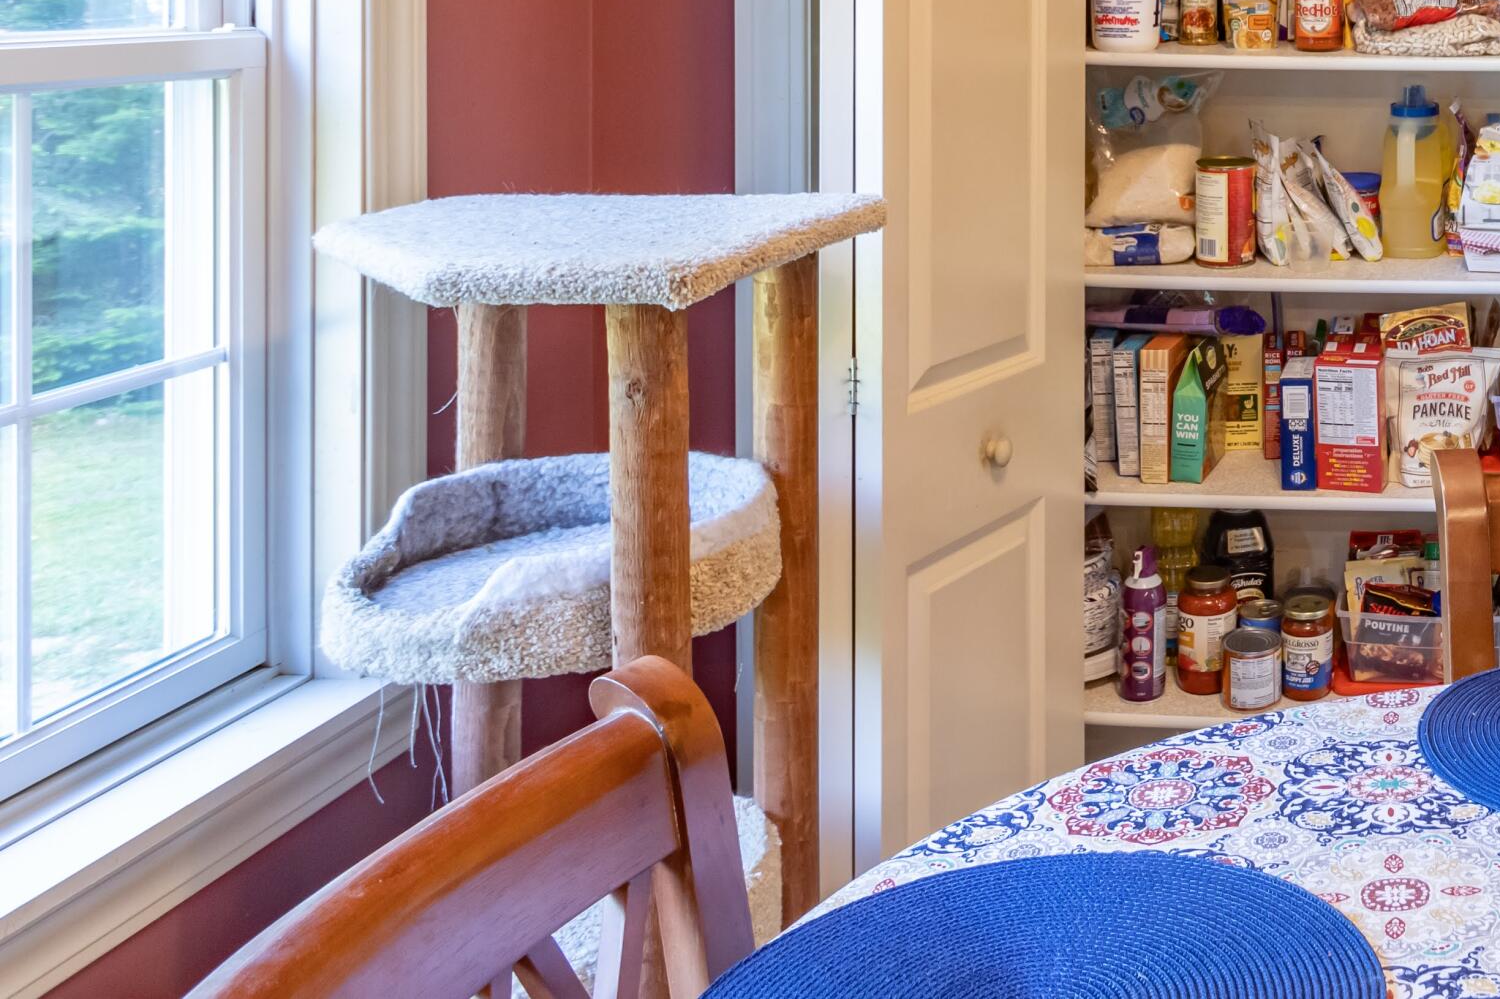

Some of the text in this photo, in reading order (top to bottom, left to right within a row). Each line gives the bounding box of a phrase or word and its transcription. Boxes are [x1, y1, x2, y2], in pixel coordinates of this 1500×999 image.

[1296, 3, 1338, 17] RedHot
[1396, 328, 1456, 351] IDAHOAN
[1427, 368, 1449, 389] Red
[1450, 365, 1472, 384] Mill
[1420, 392, 1446, 400] GLUTEN
[1412, 402, 1472, 420] PANCAKE
[1176, 414, 1199, 423] YOU
[1176, 422, 1198, 431] CAN
[1176, 430, 1199, 440] WIN!
[1364, 620, 1410, 634] POUTINE
